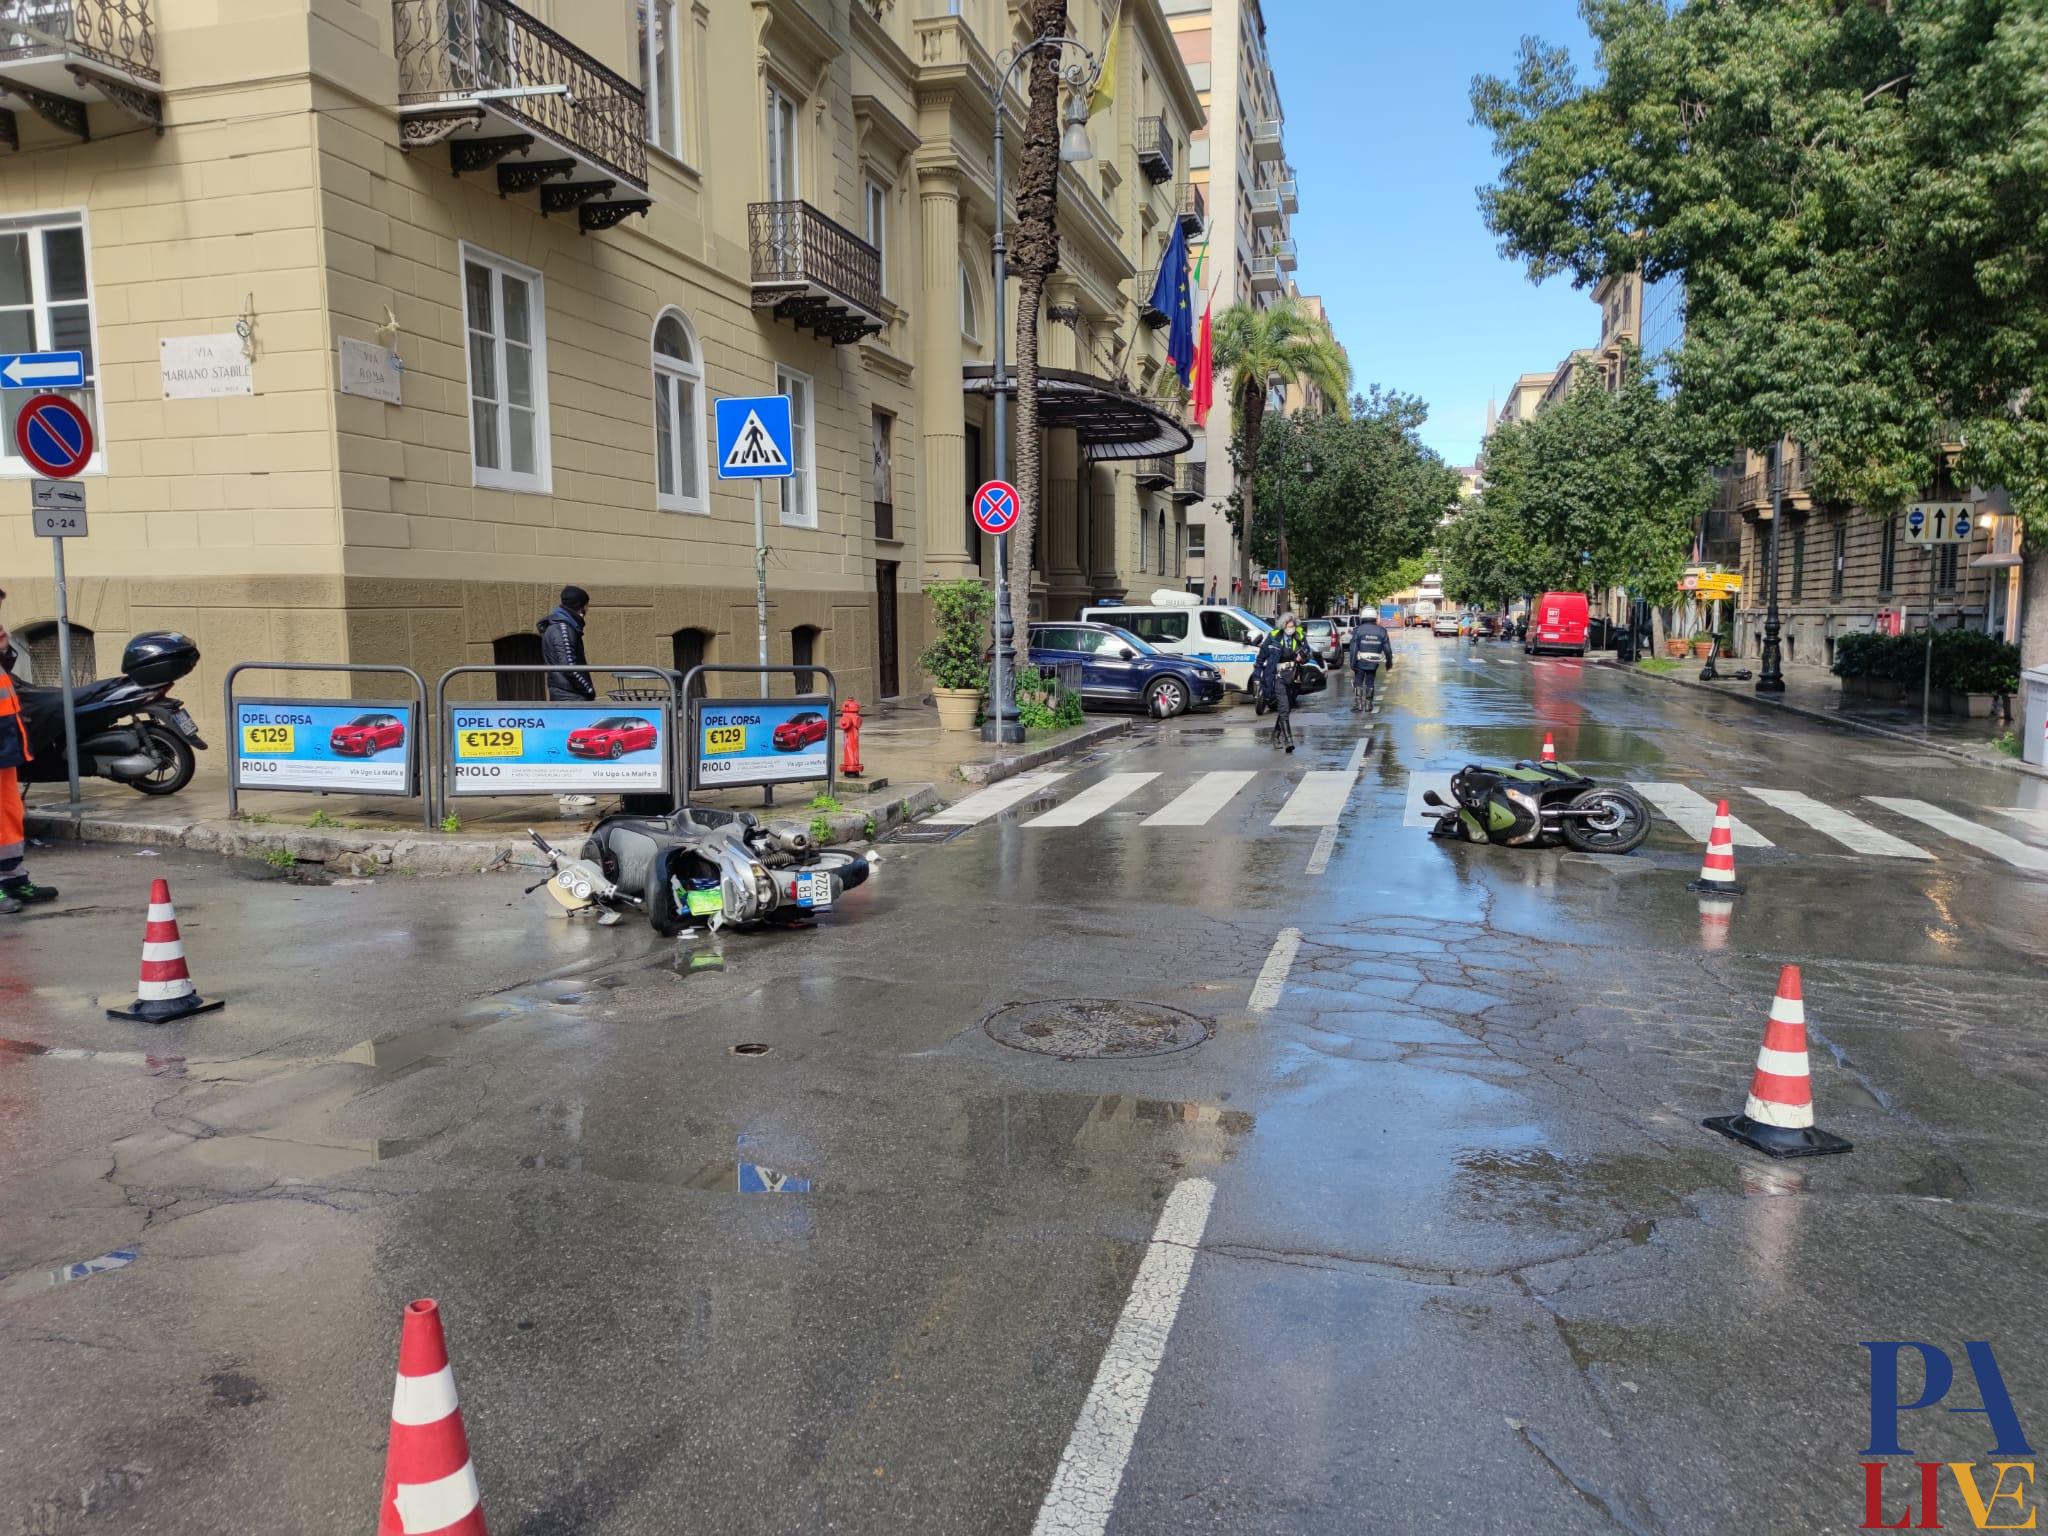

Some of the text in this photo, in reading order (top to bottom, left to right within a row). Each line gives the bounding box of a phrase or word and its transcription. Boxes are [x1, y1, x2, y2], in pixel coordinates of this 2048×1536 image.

[196, 347, 213, 358] VIA
[363, 351, 379, 363] VIA
[162, 364, 250, 382] MARIANO STABILE
[359, 367, 385, 383] ROMA
[46, 518, 76, 528] 0-24
[242, 713, 313, 725] OPEL CORSA
[457, 717, 546, 729] OPEL CORSA
[704, 715, 761, 726] OPEL CORSA
[250, 727, 288, 743] €129
[465, 731, 515, 747] €129
[710, 728, 741, 744] €129
[241, 761, 278, 772] RIOLO
[455, 766, 501, 777] RIOLO
[702, 761, 731, 772] RIOLO
[798, 886, 812, 899] EB
[815, 872, 829, 902] 13224
